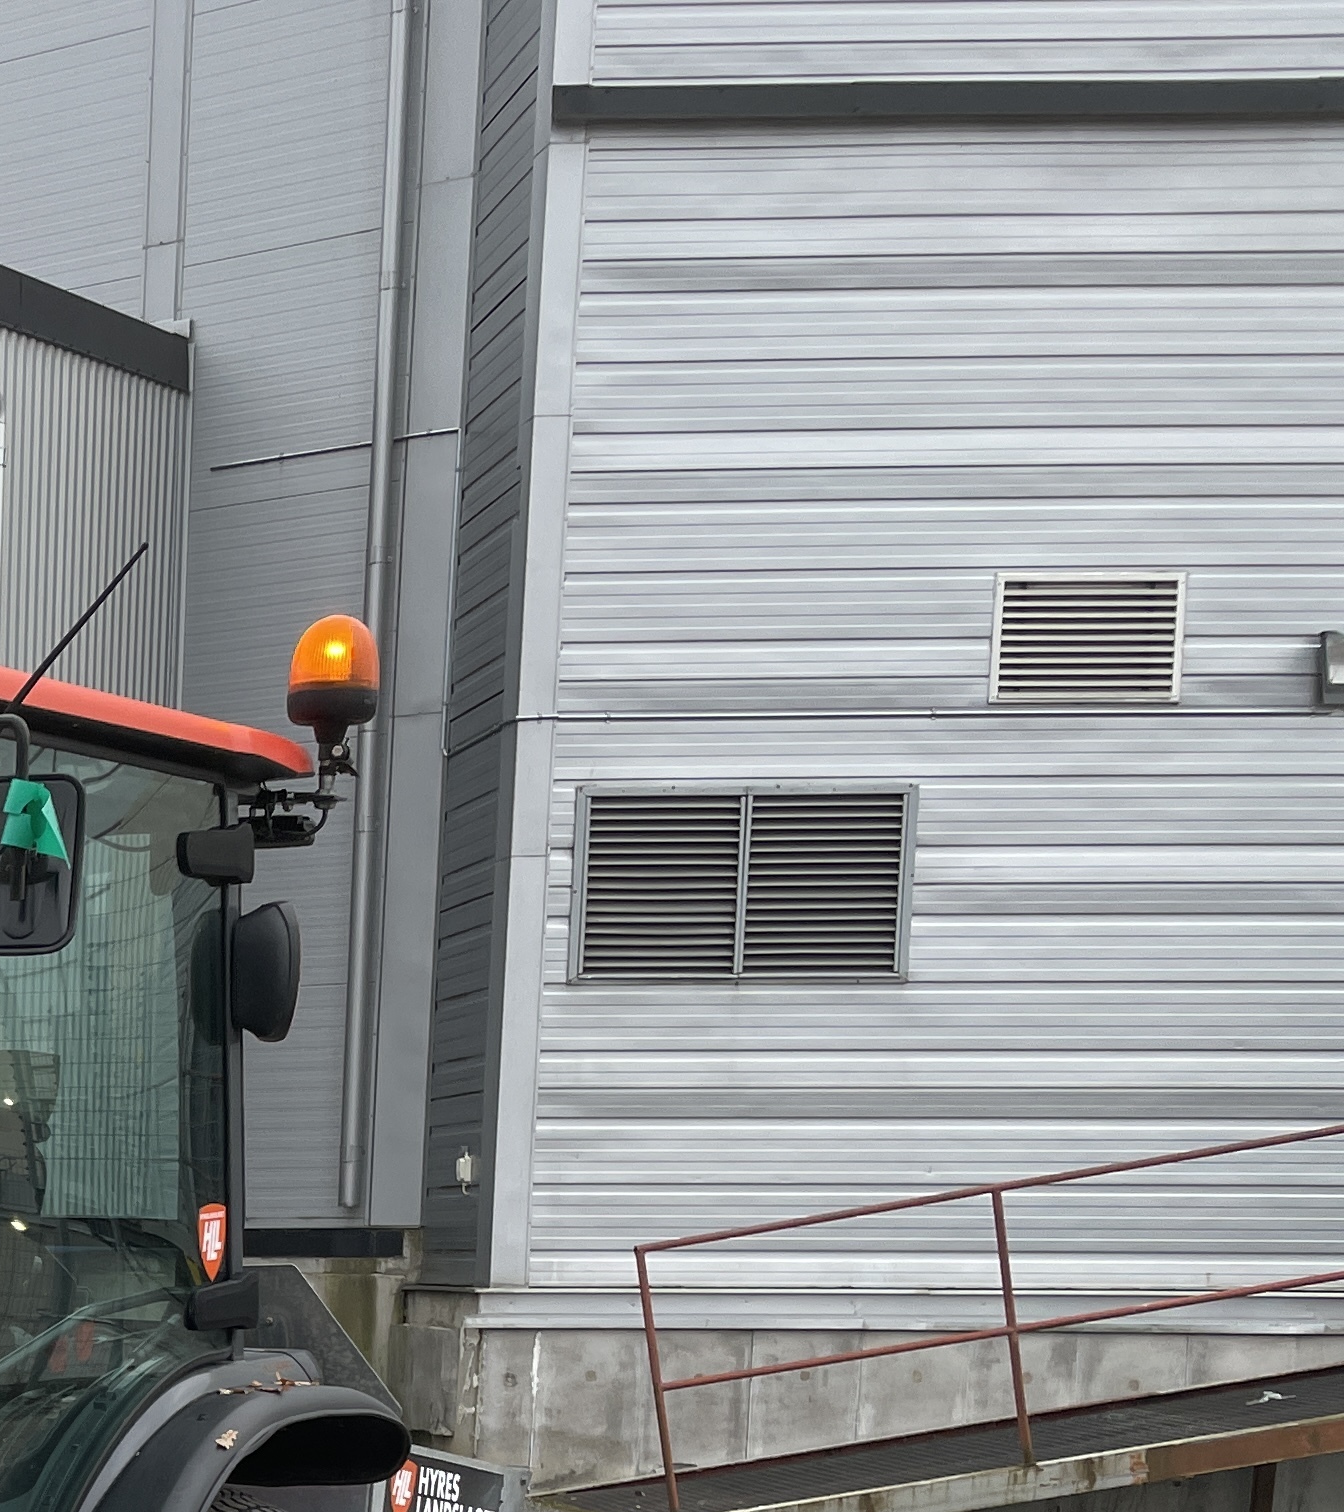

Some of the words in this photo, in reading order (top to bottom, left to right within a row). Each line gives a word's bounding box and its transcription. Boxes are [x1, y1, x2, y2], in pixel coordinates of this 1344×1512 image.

[201, 1219, 222, 1262] HLL
[392, 1469, 413, 1507] HLL
[417, 1466, 461, 1503] HYRES
